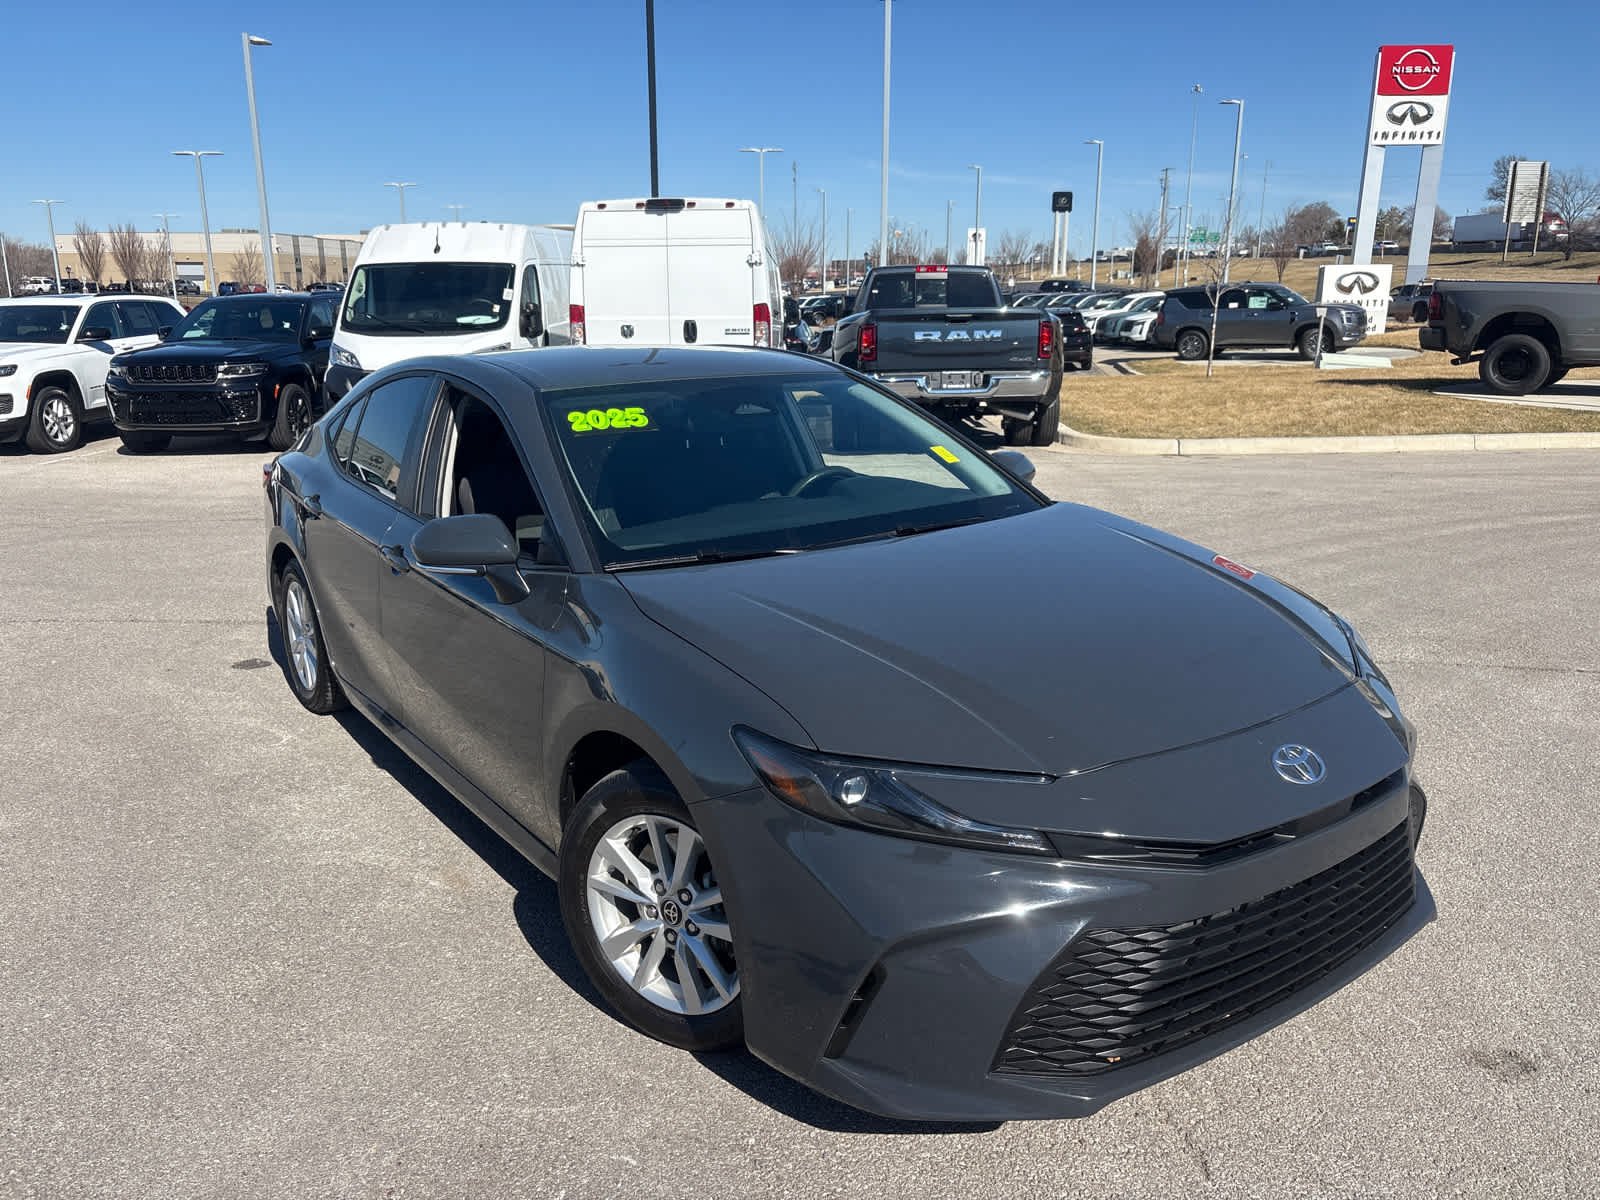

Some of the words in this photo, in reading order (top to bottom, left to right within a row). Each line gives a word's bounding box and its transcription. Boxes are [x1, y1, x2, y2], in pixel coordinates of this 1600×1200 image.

[1374, 131, 1441, 140] INFINITI
[914, 330, 1002, 342] RAM
[567, 407, 649, 432] 2025
